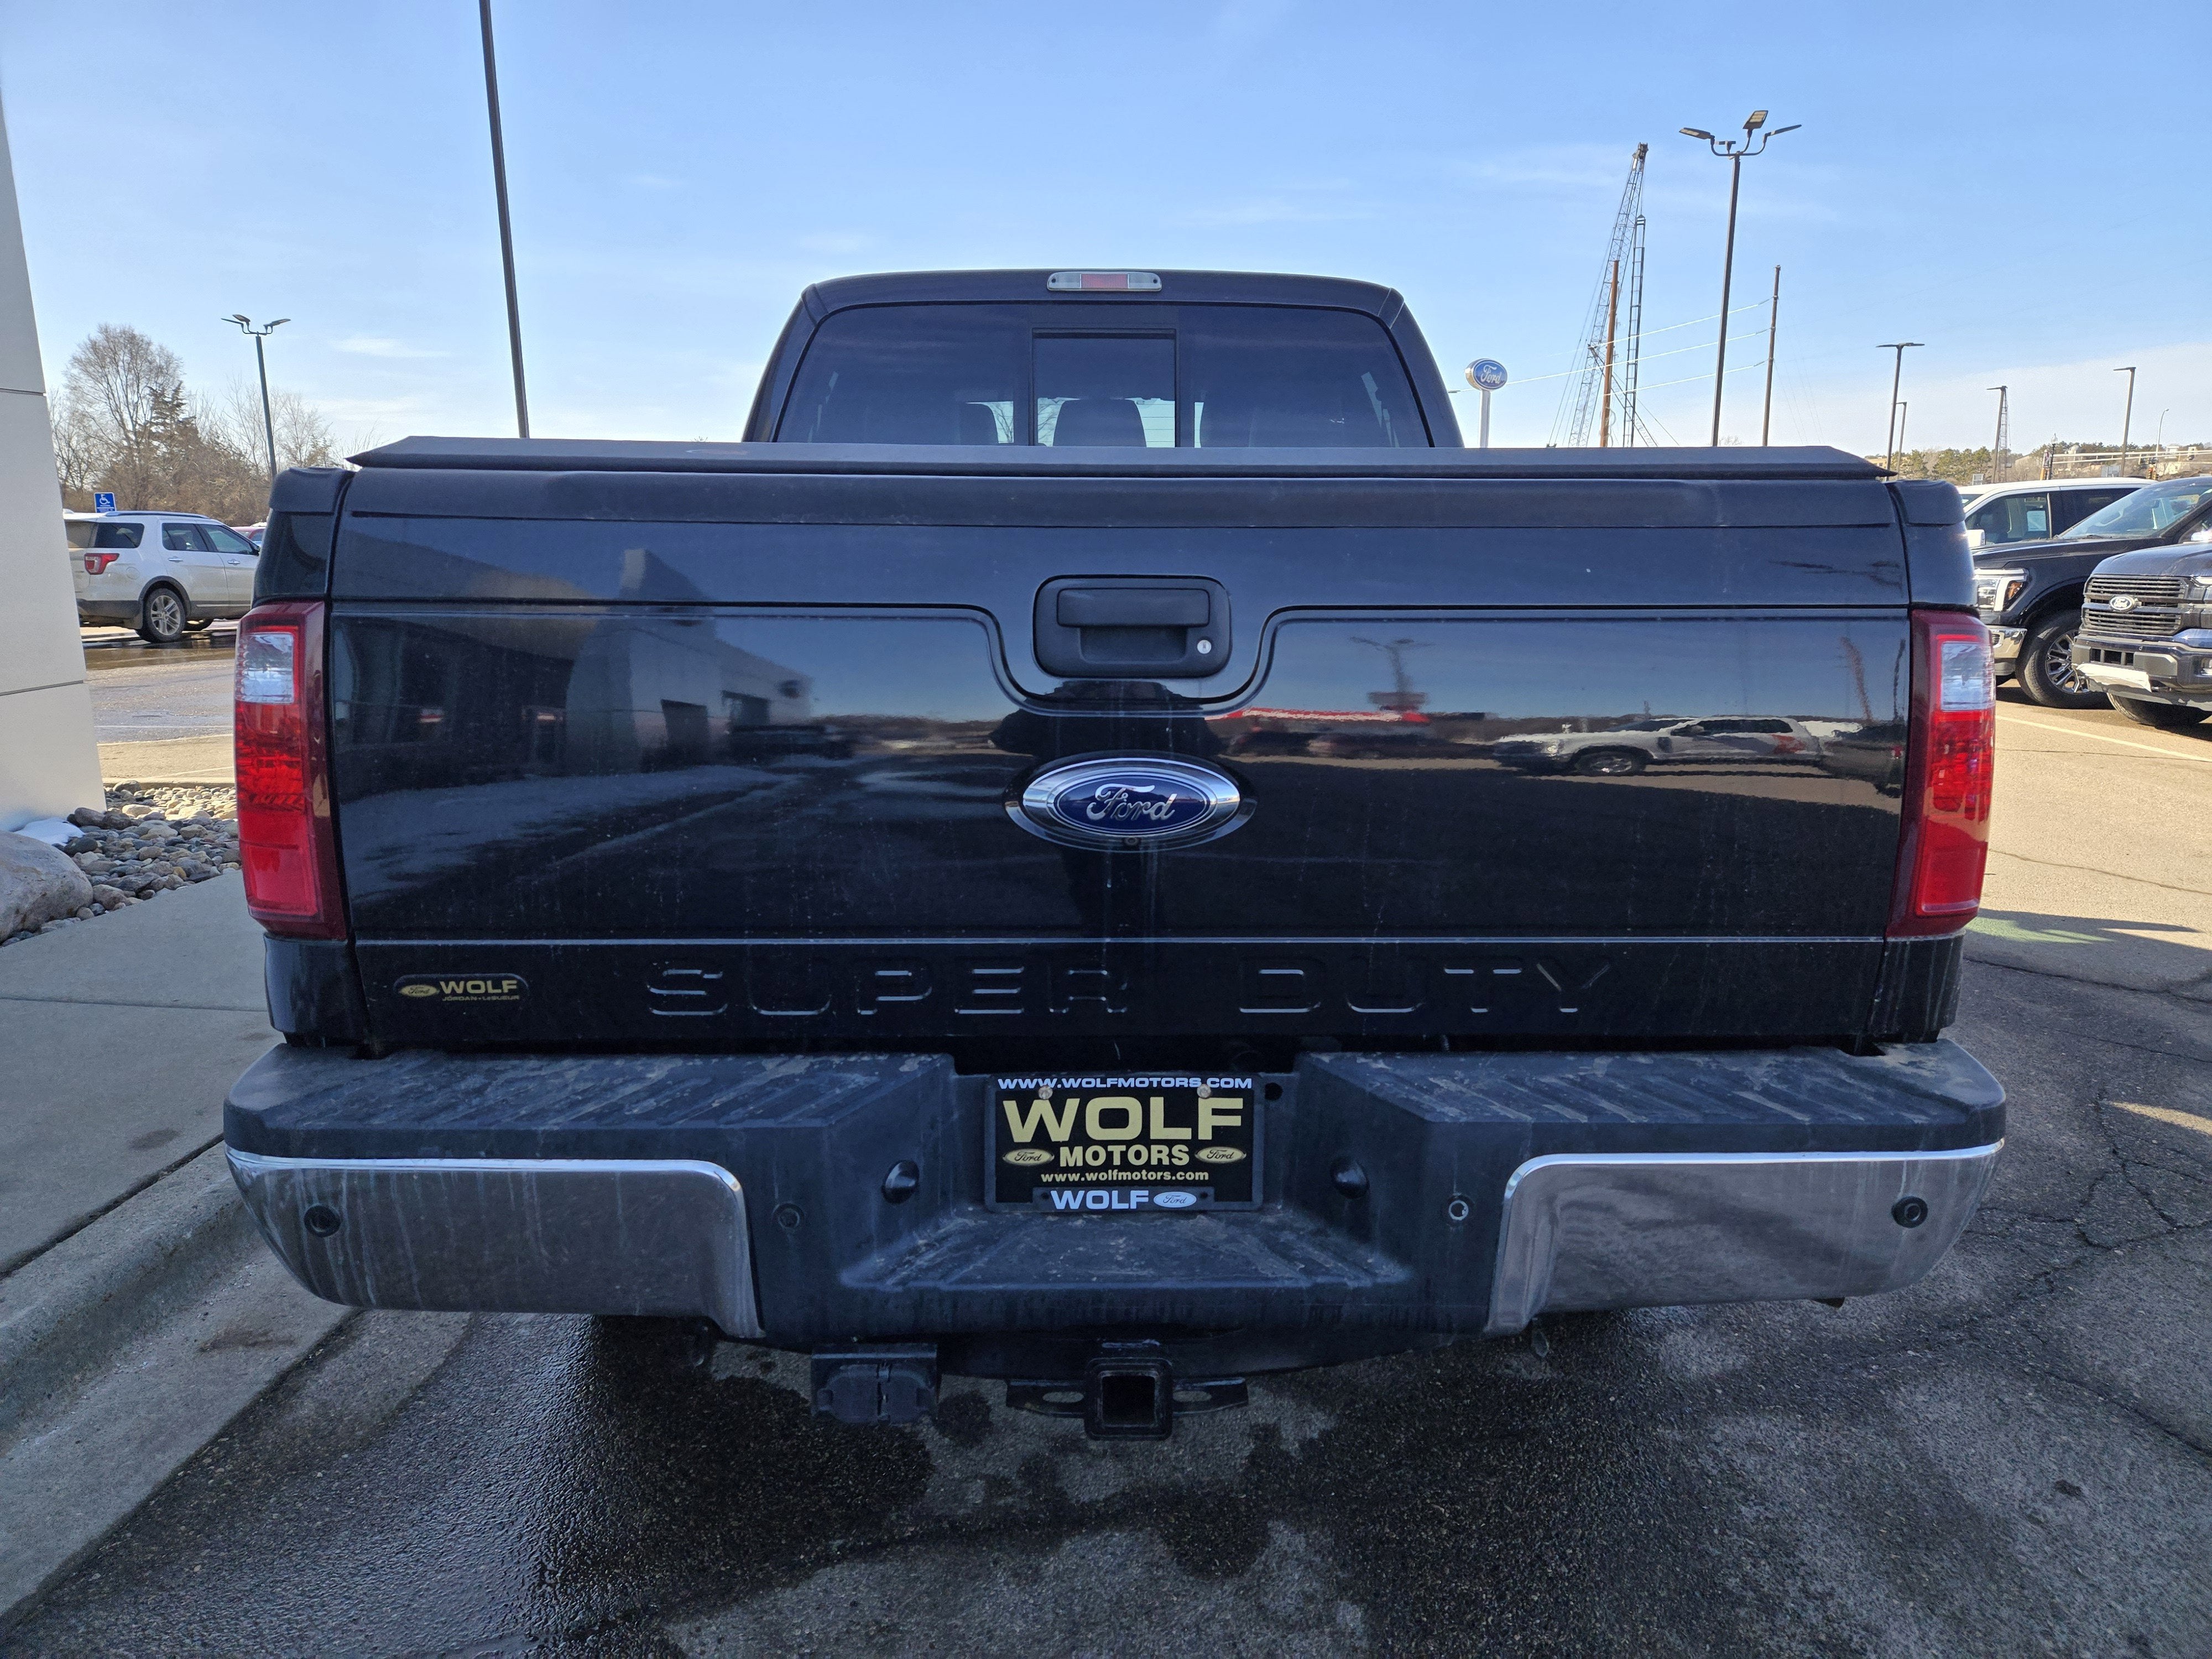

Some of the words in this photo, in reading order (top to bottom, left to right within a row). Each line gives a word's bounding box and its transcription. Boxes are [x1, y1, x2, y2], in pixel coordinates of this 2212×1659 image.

[1480, 364, 1502, 384] Ford
[1086, 783, 1178, 821] Ford
[440, 980, 518, 994] WOLF
[644, 957, 1128, 1015] SUPER
[1238, 955, 1610, 1014] DUTY
[998, 1078, 1252, 1090] WWW.WOLFMOTORSCOM
[1003, 1096, 1243, 1143] WOLF
[1013, 1151, 1043, 1162] Ford
[1060, 1144, 1190, 1167] MOTORS
[1206, 1149, 1235, 1160] Ford
[1041, 1169, 1209, 1182] www.wolfmotors.com
[1051, 1190, 1149, 1209] WOLF
[1162, 1194, 1188, 1206] Ford
